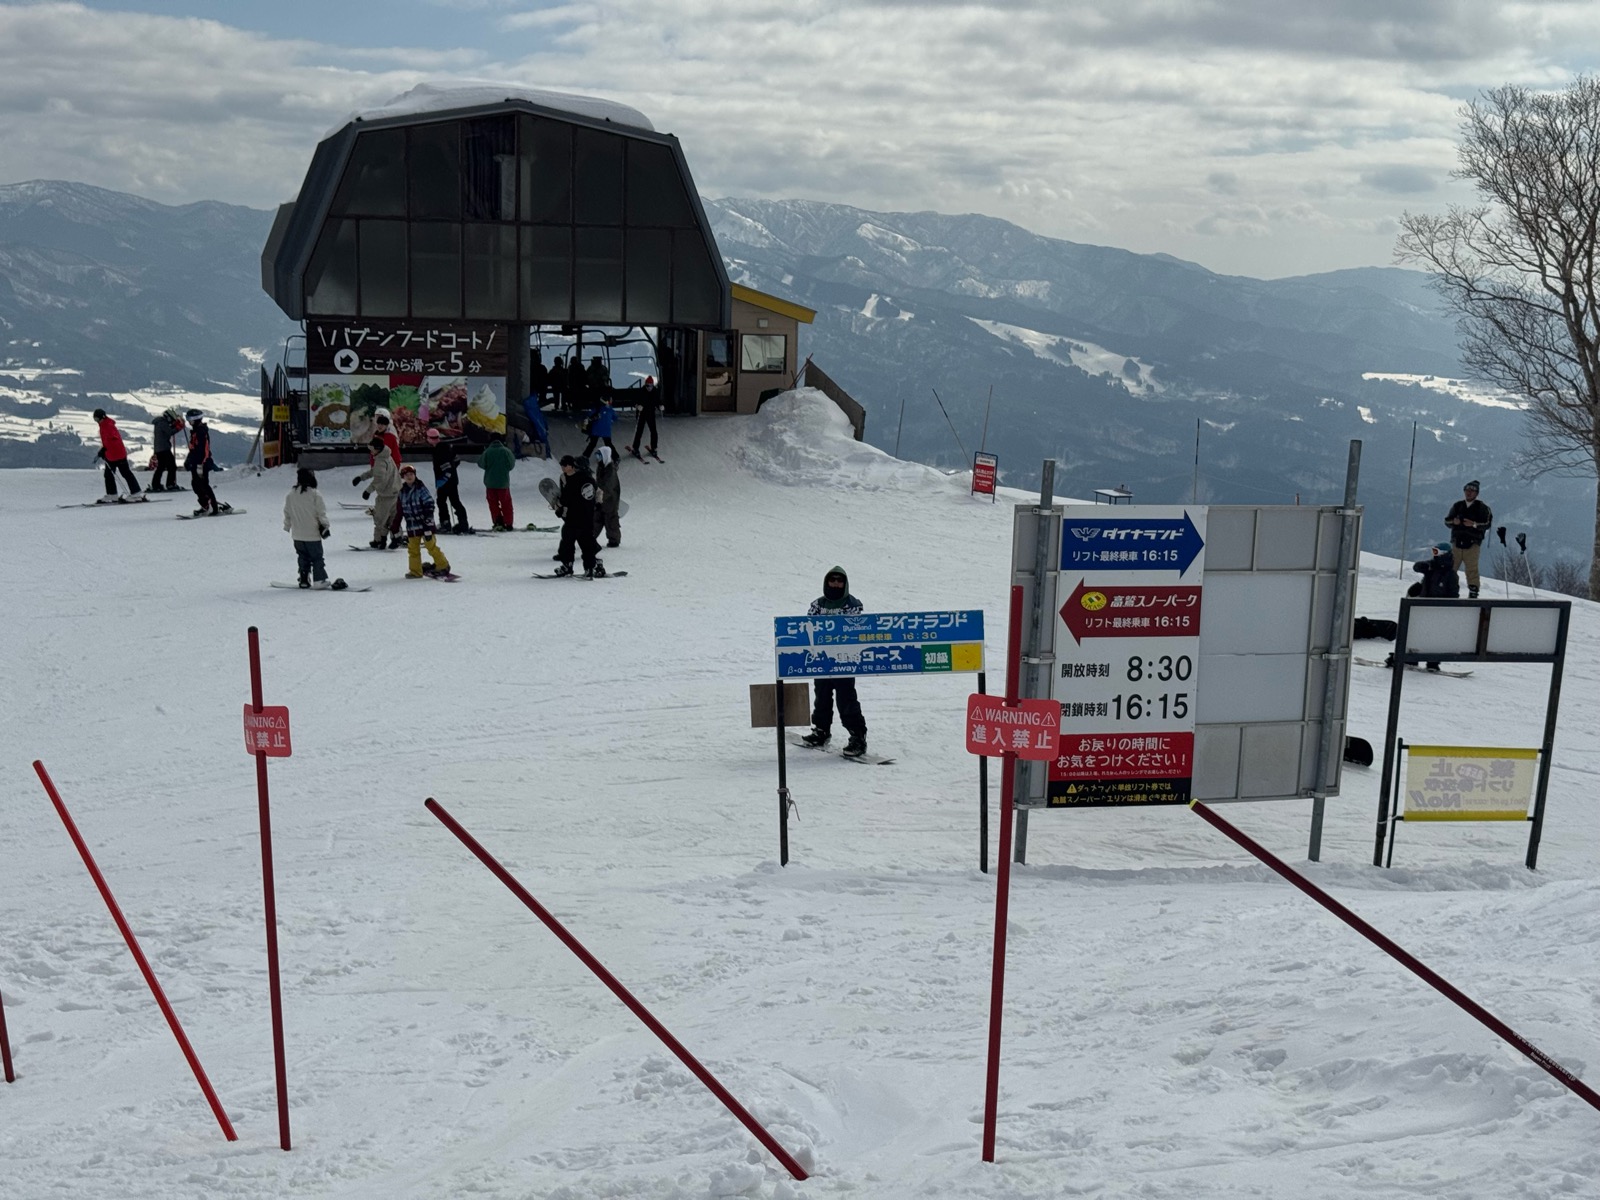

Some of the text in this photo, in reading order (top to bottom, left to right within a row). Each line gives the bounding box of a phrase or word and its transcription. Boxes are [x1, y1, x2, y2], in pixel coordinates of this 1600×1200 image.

[330, 327, 482, 350] バブーンフードコート
[1102, 528, 1184, 540] ダイナランド
[1072, 550, 1178, 561] リフト最終乗車 16:15
[1110, 594, 1198, 608] 高鷲スノーパーク
[877, 614, 968, 631] ダイナランド
[1085, 616, 1190, 628] リフト最終乗車 16:15
[925, 651, 948, 664] 初級
[1061, 655, 1192, 682] 開放時刻 8:30
[1112, 693, 1188, 720] 16:15
[985, 708, 1040, 726] WARNING
[971, 724, 1053, 750] 進入禁止
[1078, 737, 1170, 751] お戻りの時間に
